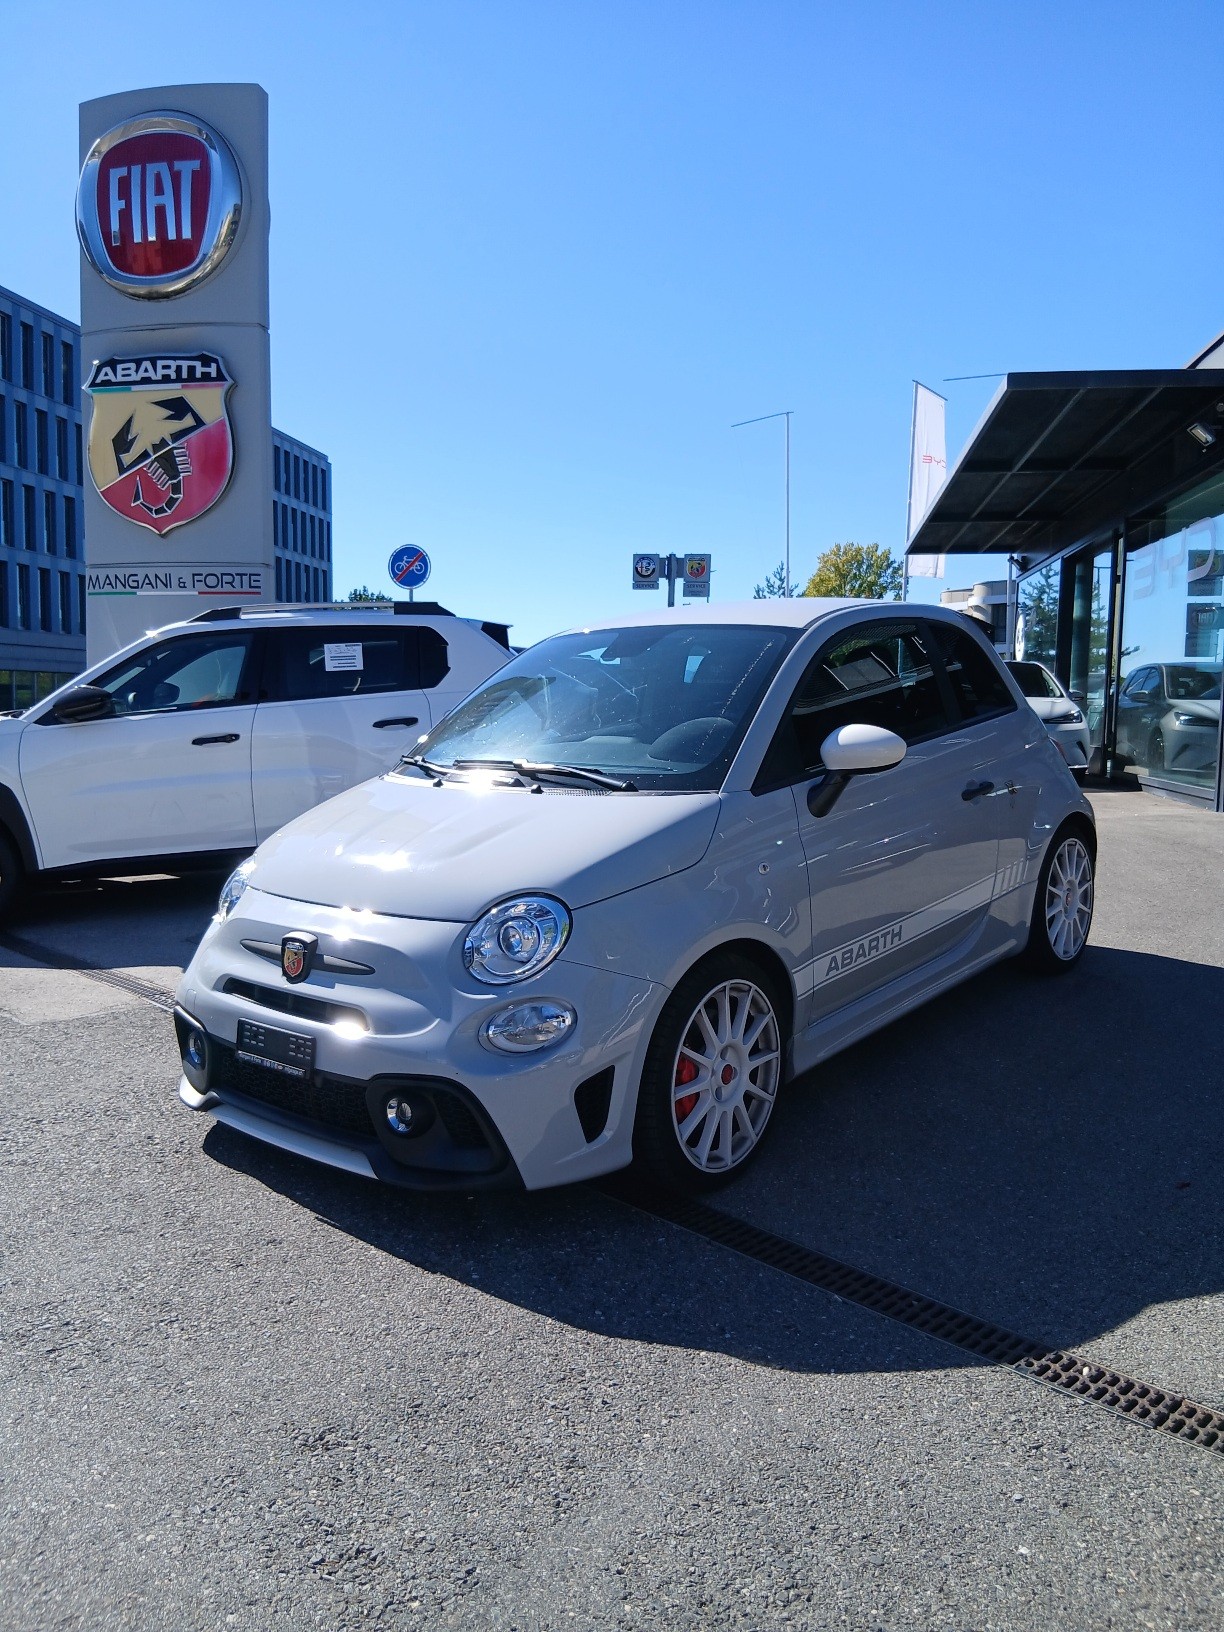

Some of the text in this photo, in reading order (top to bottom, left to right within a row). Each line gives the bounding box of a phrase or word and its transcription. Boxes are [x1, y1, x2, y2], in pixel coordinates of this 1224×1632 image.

[109, 160, 201, 247] FIAT
[95, 359, 217, 384] ABARTH
[87, 573, 262, 590] MANGANI & FORTE
[825, 925, 903, 977] ABARTH
